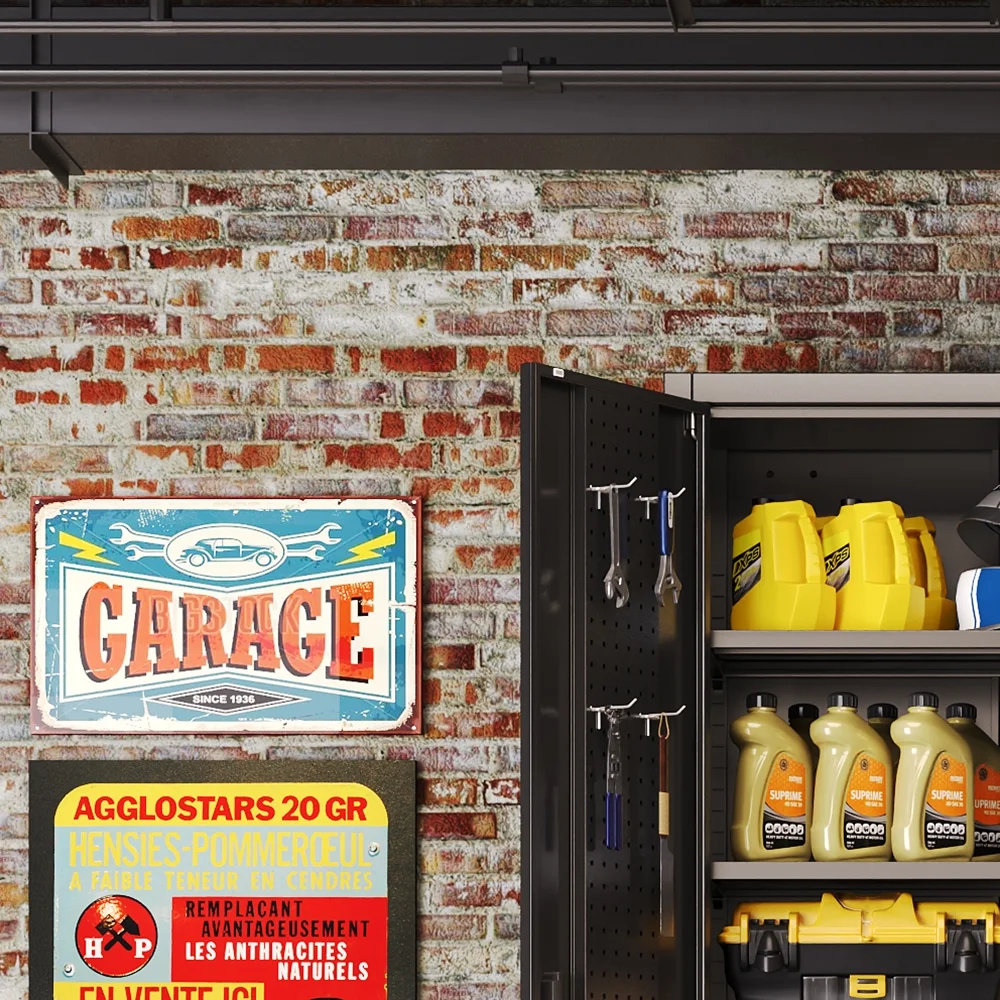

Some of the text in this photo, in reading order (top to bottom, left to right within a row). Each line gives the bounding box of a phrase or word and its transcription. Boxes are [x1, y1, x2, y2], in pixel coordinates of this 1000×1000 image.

[80, 581, 375, 683] GARAGE
[192, 694, 256, 705] SINCE 1936
[769, 789, 803, 802] SUPRIME
[850, 789, 883, 802] SUPRIME
[931, 789, 964, 802] SUPRIME
[974, 799, 1000, 810] UPRIME
[73, 796, 368, 821] AGGLOSTARS 20 GR
[68, 831, 373, 868] HENSIES-POMMERŒUL
[91, 872, 153, 891] FAIBLE
[164, 872, 239, 891] TENEUR
[250, 872, 275, 891] EN
[286, 872, 373, 891] CENDRES
[185, 900, 303, 919] REMPLAÇANT
[201, 920, 370, 938] AVANTAGEUSEMENT
[83, 937, 103, 959] H
[134, 937, 153, 959] P
[185, 942, 348, 961] LES ANTHRACITES
[277, 961, 369, 981] NATURELS
